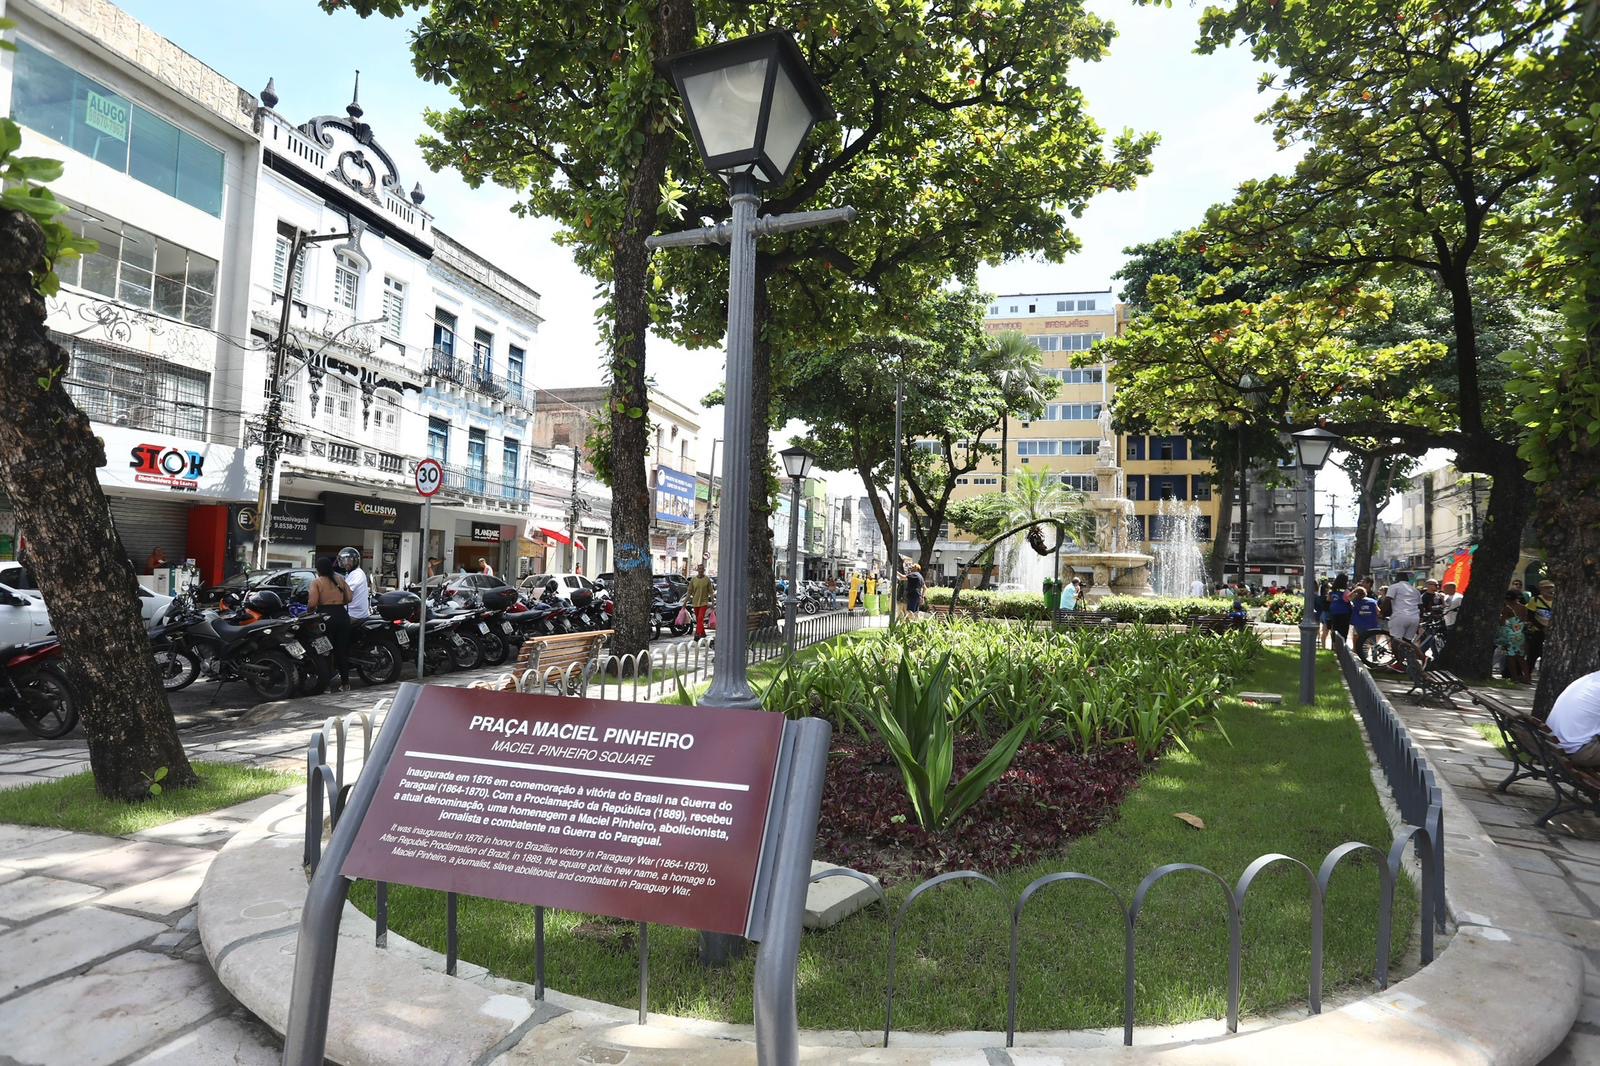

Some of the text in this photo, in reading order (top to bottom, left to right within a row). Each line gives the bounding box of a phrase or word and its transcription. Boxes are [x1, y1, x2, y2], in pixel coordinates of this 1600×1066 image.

[90, 95, 125, 124] ALUGO
[129, 446, 204, 477] STOK
[419, 467, 438, 483] 30
[273, 515, 309, 524] exclusivagold
[354, 501, 397, 517] EXCLUSIVA
[469, 716, 695, 750] PRAÇA MACIEL PINHEIRO
[490, 741, 656, 767] MACIEL PINHEIRO SQUARE
[398, 779, 733, 826] Paraguai (1864-1870). Com a Proclamação da República (1889), recebeu
[406, 767, 733, 811] Inaugurada em 1876 em comemoração à vitória do Brasil na Guerra do
[400, 793, 424, 803] atual
[423, 795, 485, 812] denominação,
[487, 805, 508, 814] uma
[508, 805, 568, 822] homenagem
[568, 814, 577, 822] a
[577, 813, 611, 826] Maciel
[611, 817, 657, 833] Pinheiro,
[658, 823, 729, 842] abolicionista,
[437, 810, 662, 847] jornalista e combatente na Guerra do Paraguai.
[378, 834, 716, 887] After Republic Proclamation of Brazil, in 1889, the square got its new name, a homage to
[390, 824, 709, 875] It was inaugurated in 1876 in honor to Brazilian victory in Paraguay War (1864-1870).
[391, 847, 418, 857] Maciel
[415, 850, 447, 863] Pinheiro,
[453, 856, 491, 870] journalist,
[492, 862, 514, 873] slave
[514, 866, 558, 879] abolitionist
[556, 873, 575, 881] and
[574, 875, 619, 887] combatant
[618, 879, 628, 888] in
[628, 880, 671, 896] Paraguay
[672, 885, 691, 897] War.
